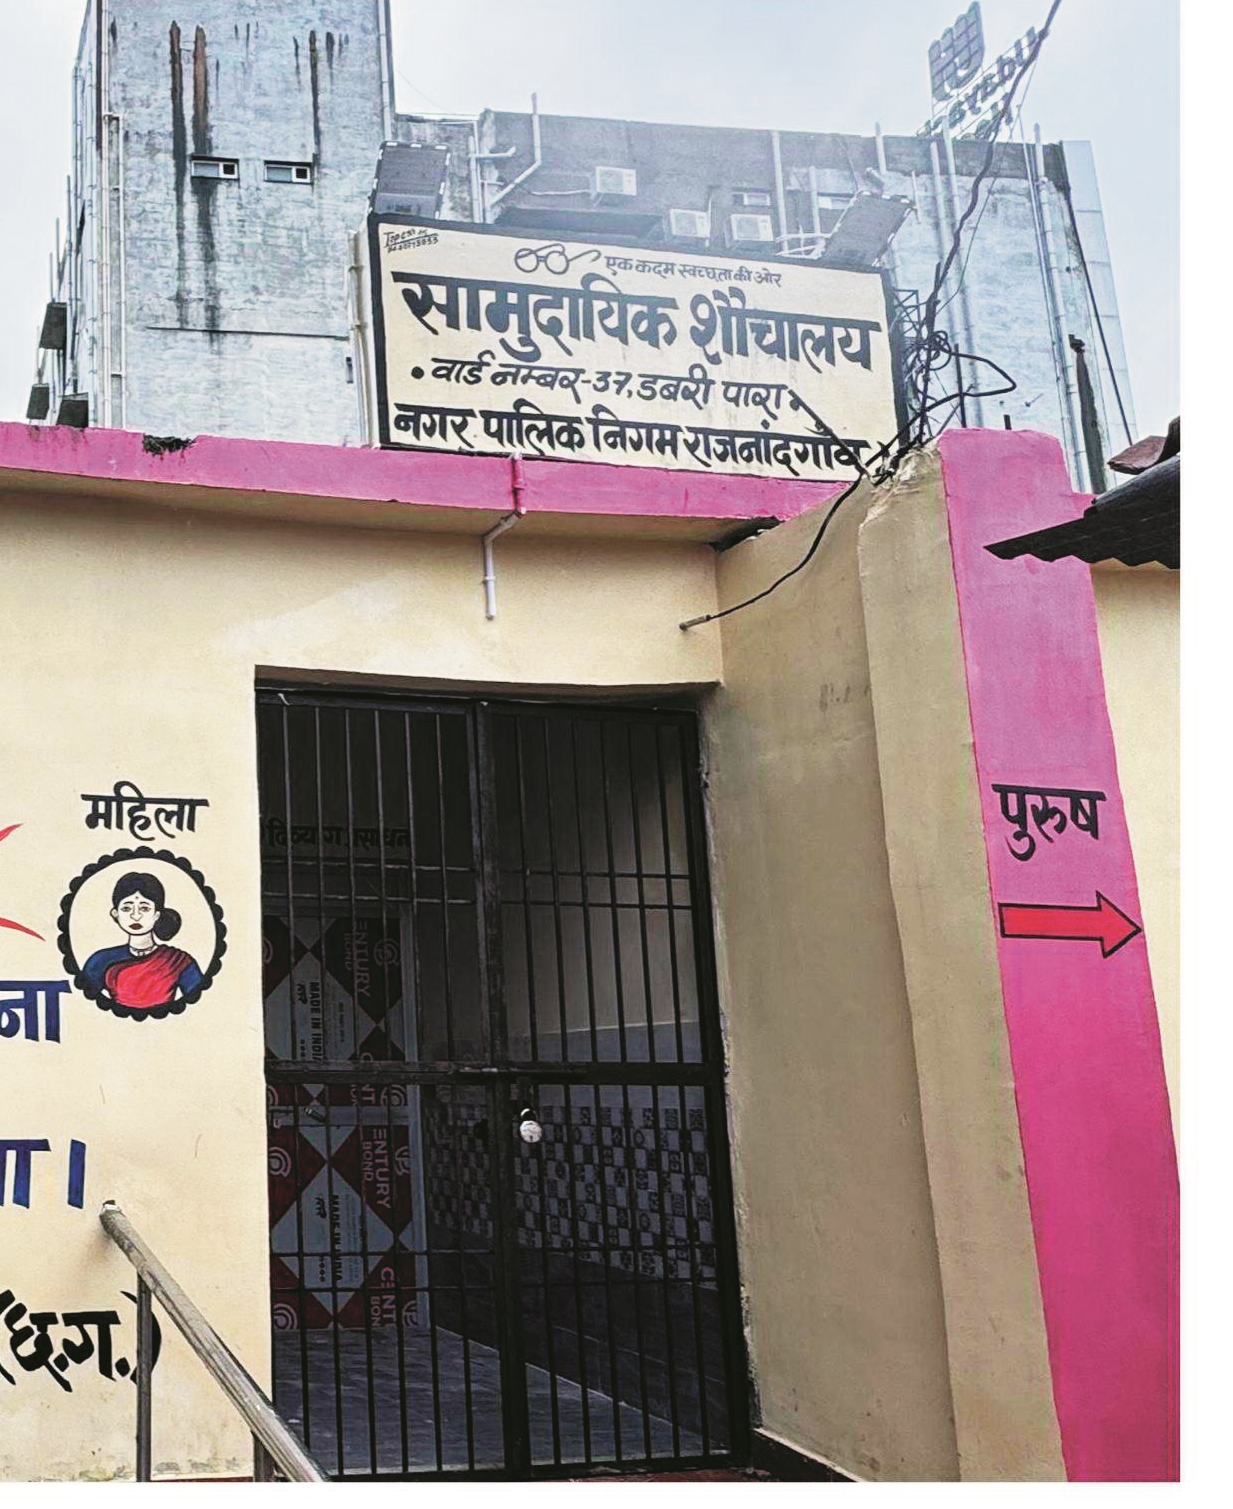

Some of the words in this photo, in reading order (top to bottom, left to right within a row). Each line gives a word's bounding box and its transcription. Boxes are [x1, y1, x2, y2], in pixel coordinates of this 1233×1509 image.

[604, 255, 633, 276] एक
[634, 259, 677, 279] कदम
[732, 265, 752, 282] की
[753, 268, 782, 287] ओर
[391, 272, 679, 361] सामुदायिक
[689, 286, 882, 372] शौचालय
[432, 349, 496, 385] वार्ड
[721, 380, 791, 421] पारा
[394, 402, 476, 448] नगर
[480, 398, 586, 457] पालिक
[591, 404, 682, 460] निगम
[81, 780, 210, 841] महिला
[991, 783, 1107, 862] पुरुष
[308, 981, 321, 1014] MADE
[310, 1017, 322, 1029] IN
[362, 1141, 374, 1181] BOND
